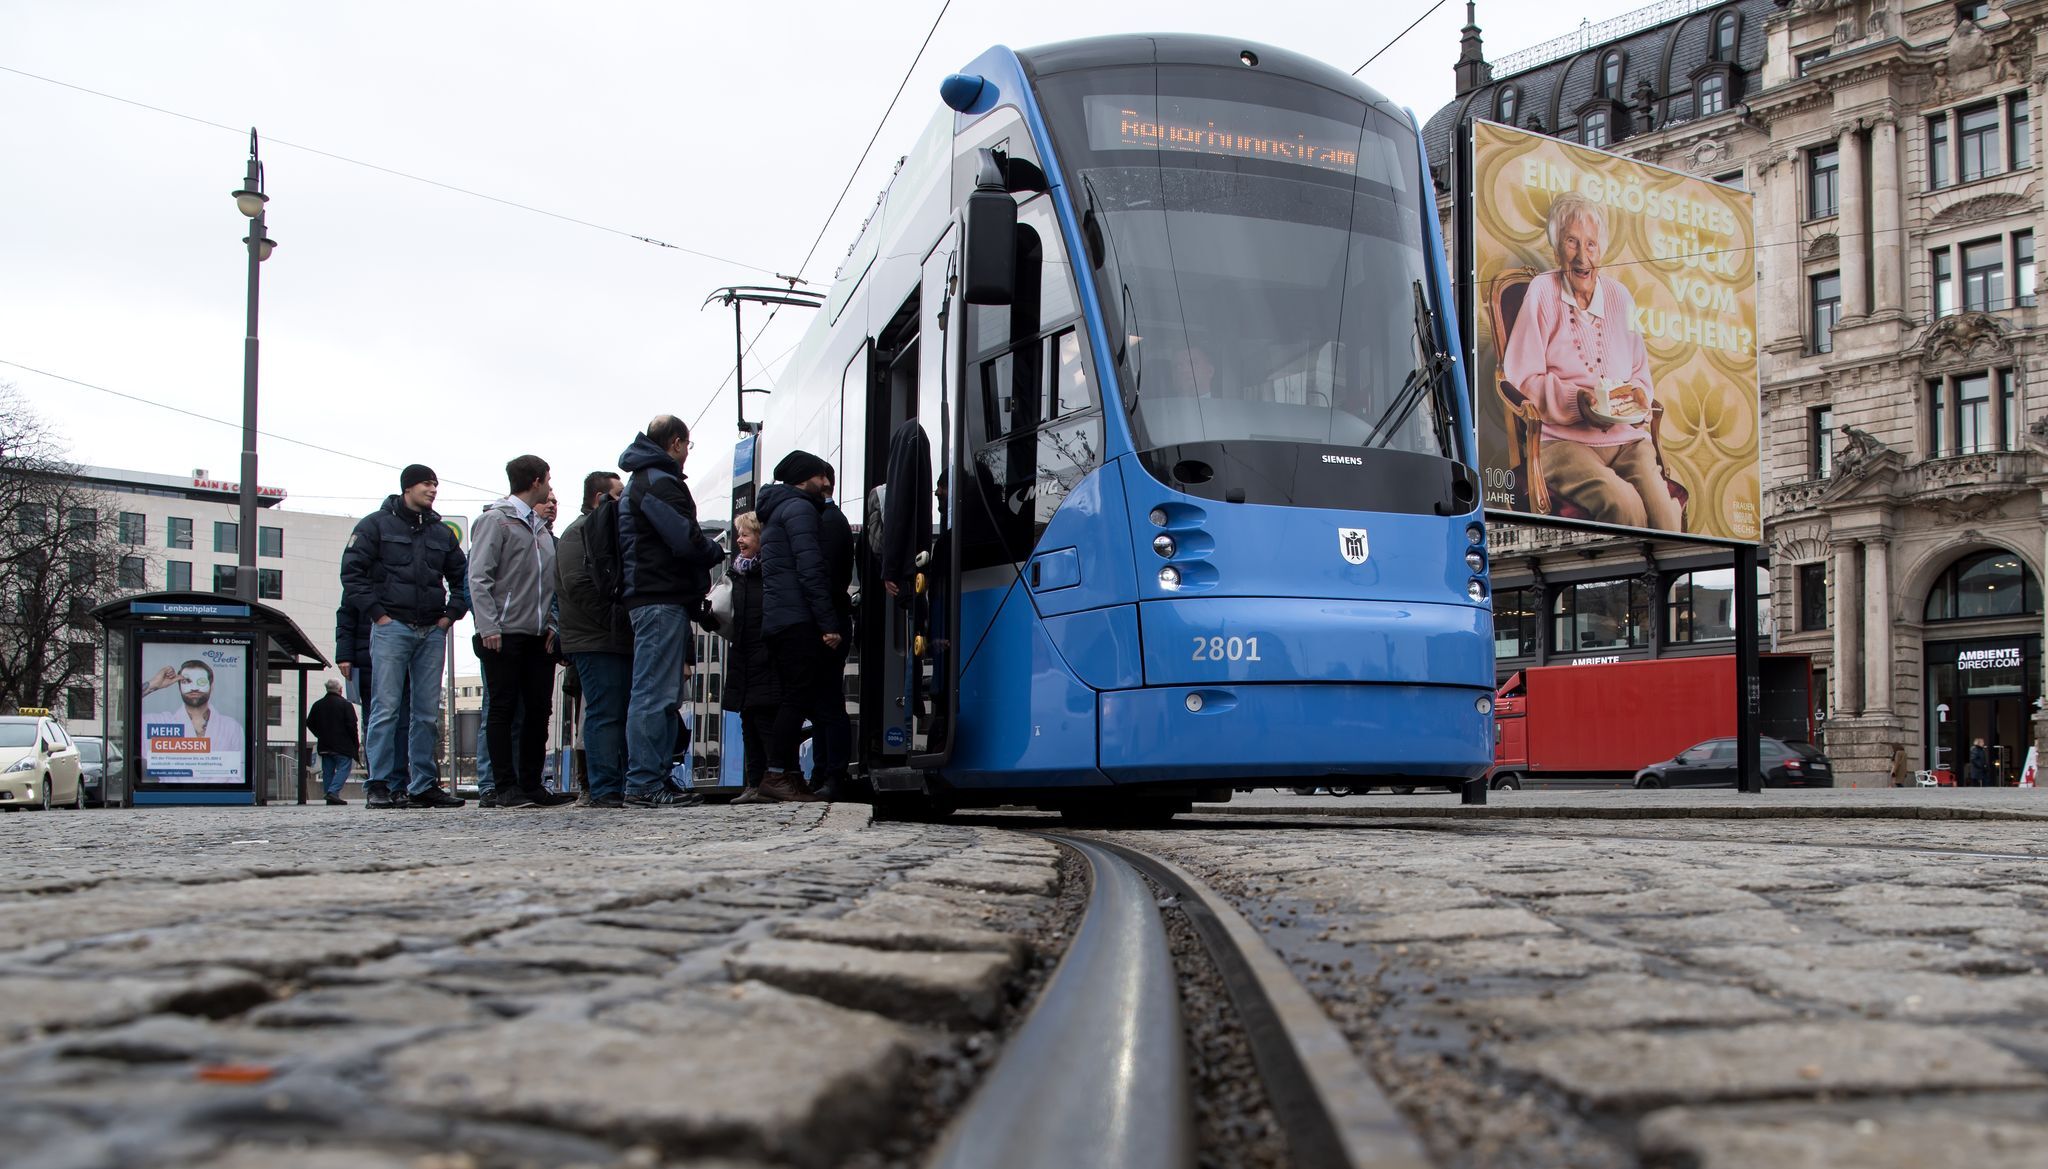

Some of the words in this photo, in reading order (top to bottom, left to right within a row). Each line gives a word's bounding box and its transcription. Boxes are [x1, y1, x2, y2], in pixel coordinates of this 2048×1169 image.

[1523, 158, 1573, 193] EIN
[1583, 174, 1735, 236] GRÖSSERES
[1653, 230, 1736, 277] STÜCK
[1670, 274, 1737, 314] VOM
[1628, 304, 1752, 354] KUCHEN?
[1321, 454, 1363, 466] SIEMENS
[1485, 467, 1516, 490] 100
[193, 479, 219, 489] BAIN
[222, 482, 229, 491] &
[231, 484, 283, 495] CPANY
[1023, 479, 1059, 501] MVG
[735, 495, 747, 509] 2801
[1486, 491, 1515, 505] JAHRE
[163, 604, 218, 614] Lenbachplatz
[1191, 636, 1261, 661] 2801
[1958, 648, 2020, 661] AMBIENTE
[1572, 656, 1620, 666] AMBIENTE
[1957, 658, 2020, 670] DIRECT.COM
[151, 727, 181, 736] MEHR
[155, 740, 207, 750] GELASSEN
